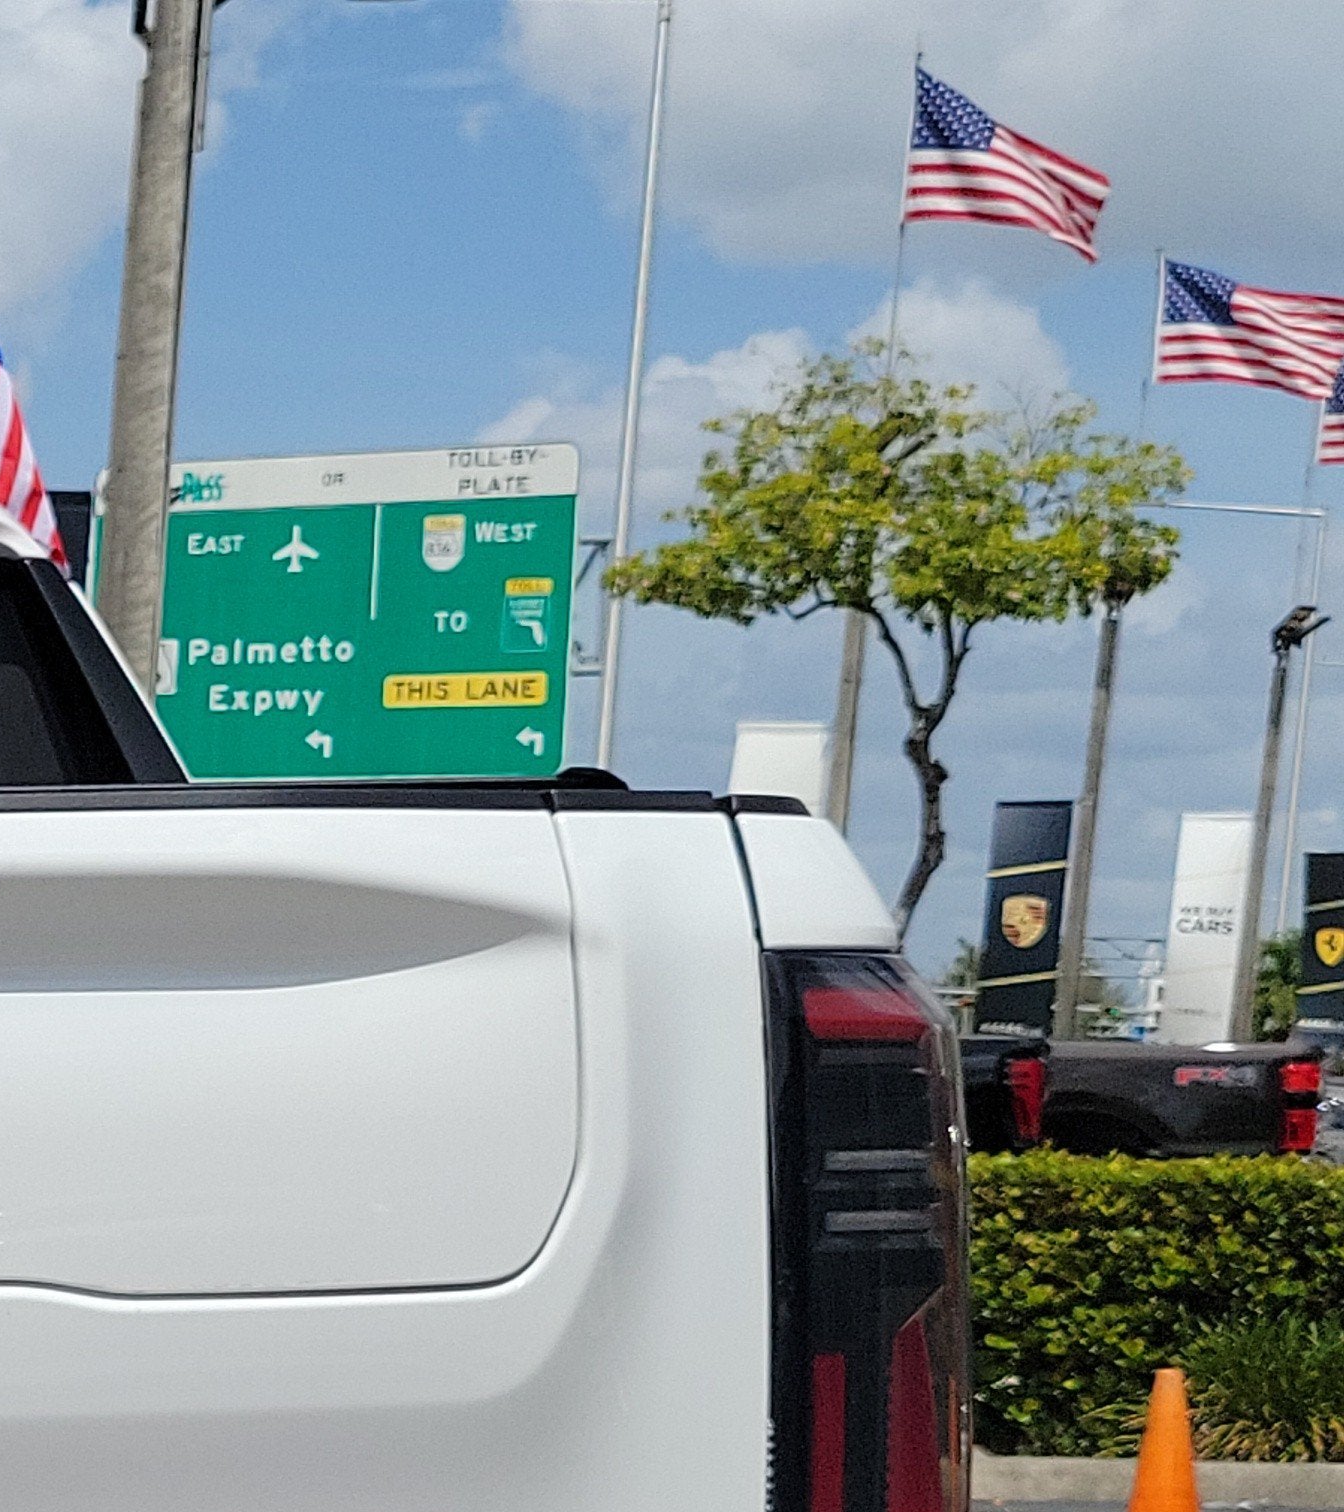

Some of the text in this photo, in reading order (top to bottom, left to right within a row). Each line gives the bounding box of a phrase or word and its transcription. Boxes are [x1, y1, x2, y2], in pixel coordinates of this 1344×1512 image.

[457, 475, 531, 495] PLATE
[474, 520, 538, 544] WEST
[187, 533, 245, 556] EAST
[433, 610, 468, 633] TO
[188, 634, 356, 666] Palmetto
[208, 684, 325, 716] Expwy
[392, 678, 537, 701] THIS LANE
[1176, 919, 1233, 935] CARS
